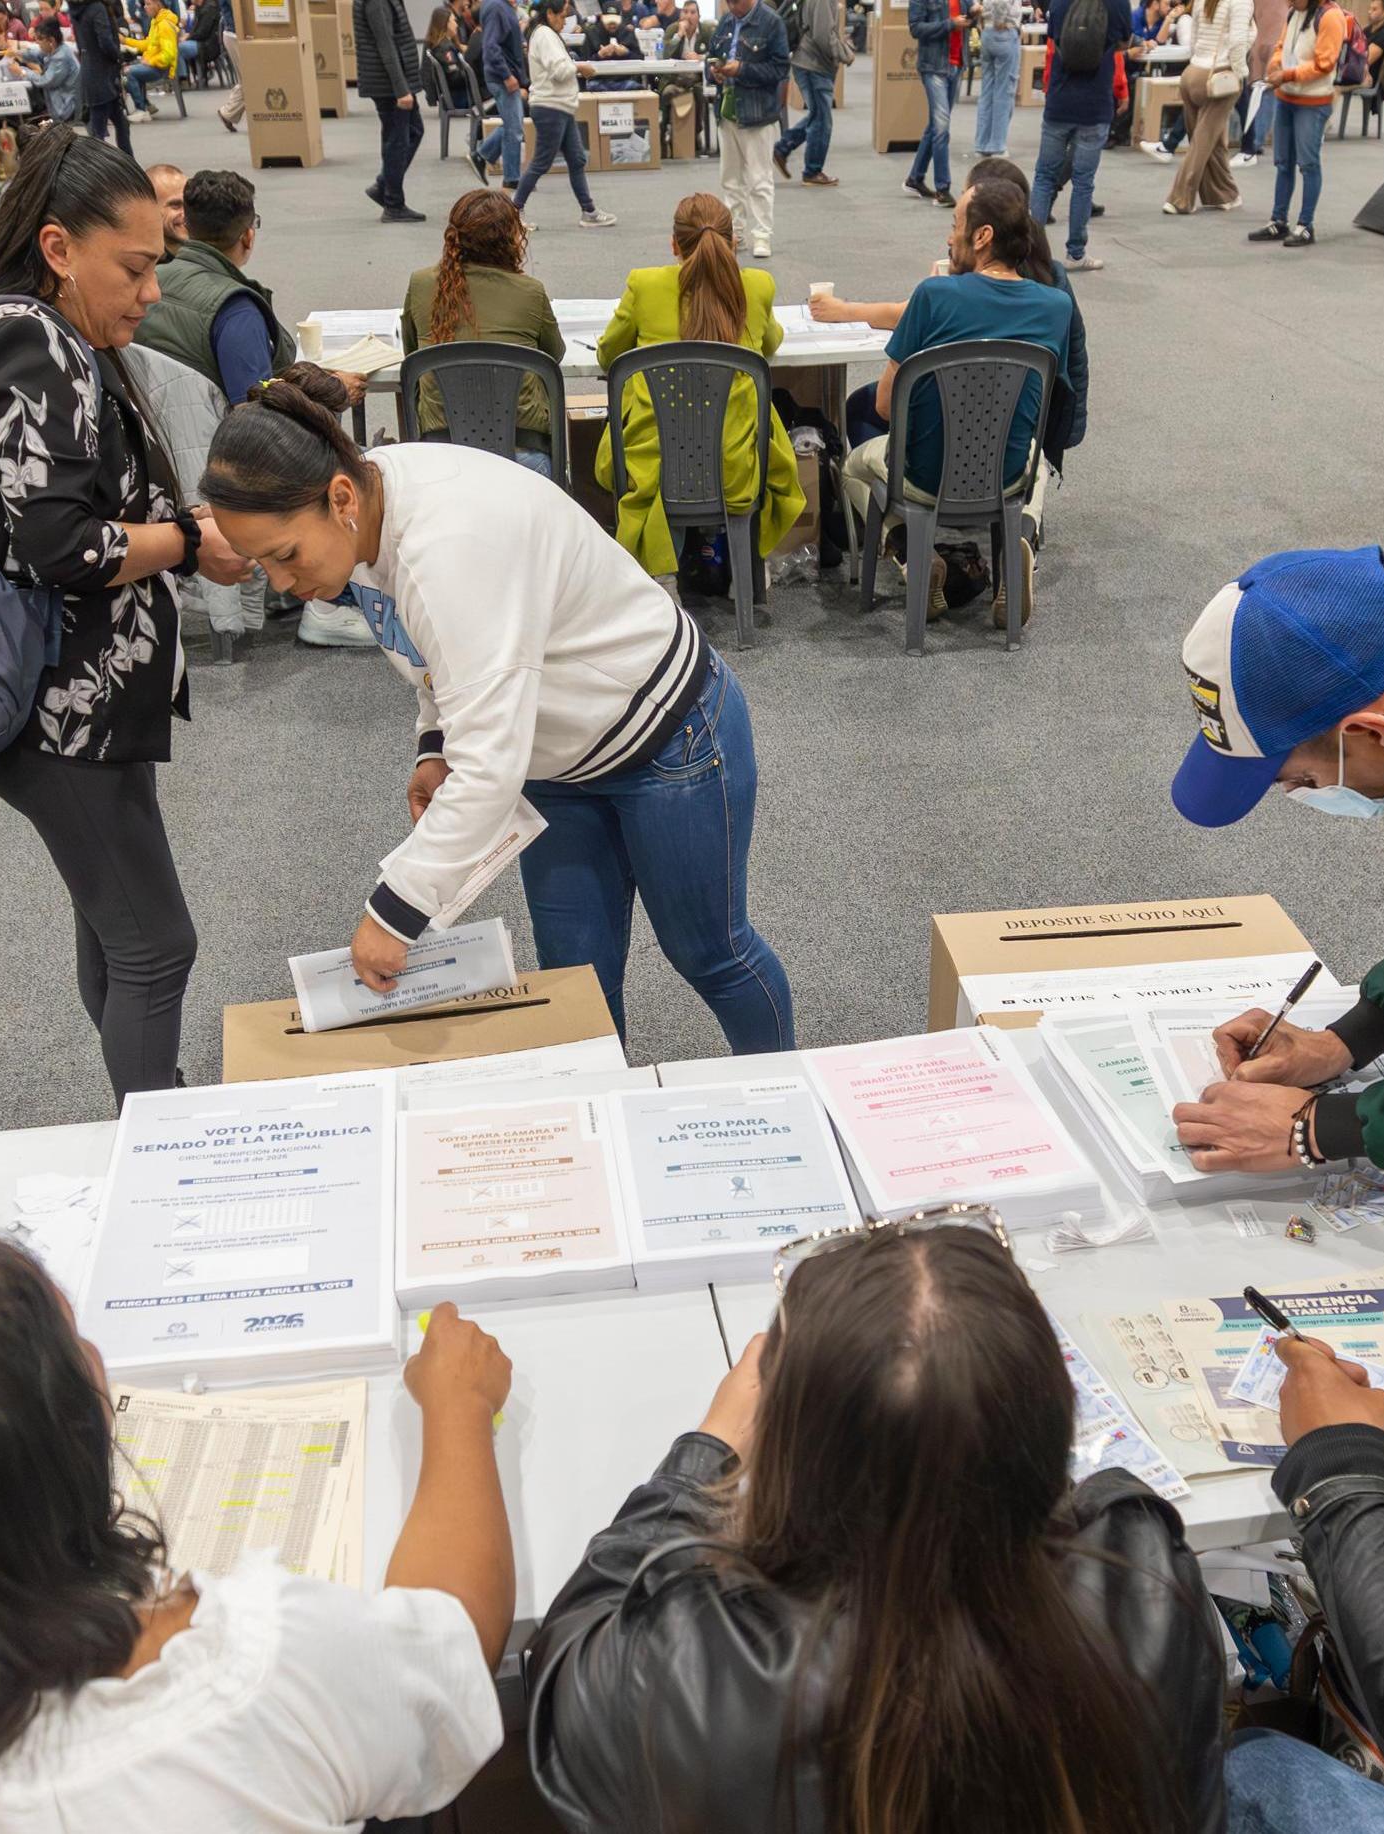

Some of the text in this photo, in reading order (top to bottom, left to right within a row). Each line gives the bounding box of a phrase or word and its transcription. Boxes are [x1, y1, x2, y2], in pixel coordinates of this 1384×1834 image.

[1004, 906, 1226, 930] DEPOSITE SU VOTO AQUÍ
[484, 983, 530, 1000] AQUÍ
[1137, 986, 1213, 998] CERRADA
[359, 1001, 398, 1015] NACIONAL
[881, 1059, 947, 1074] VOTO PARA
[850, 1075, 893, 1088] SENADO
[854, 1083, 936, 1100] COMUNIDADES
[205, 1121, 304, 1137] VOTO PARA
[676, 1117, 768, 1131] VOTO PARA
[132, 1125, 372, 1153] SENADO DE LA REPÚBLICA
[438, 1134, 468, 1144] VOTO
[471, 1130, 500, 1139] PARA
[554, 1125, 568, 1133] DE
[453, 1135, 556, 1149] REPRESENTANTES
[658, 1125, 792, 1144] LAS CONSULTAS
[178, 1144, 323, 1162] CIRCUNSCRIPCIÓN NACIONAL
[988, 1165, 1029, 1180] 2026
[757, 1224, 798, 1237] 2026
[520, 1248, 563, 1261] 2026
[110, 1298, 157, 1309] MARCAR
[186, 1294, 201, 1302] DE
[204, 1292, 229, 1301] UNA
[230, 1288, 261, 1299] LISTA
[264, 1285, 301, 1296] ANULA
[303, 1284, 317, 1292] EL
[318, 1280, 349, 1290] VOTO
[1244, 1295, 1379, 1311] VERTENCIA
[1292, 1305, 1359, 1316] TARJETAS
[244, 1313, 304, 1330] 2026
[1174, 1316, 1216, 1324] CONGRESO
